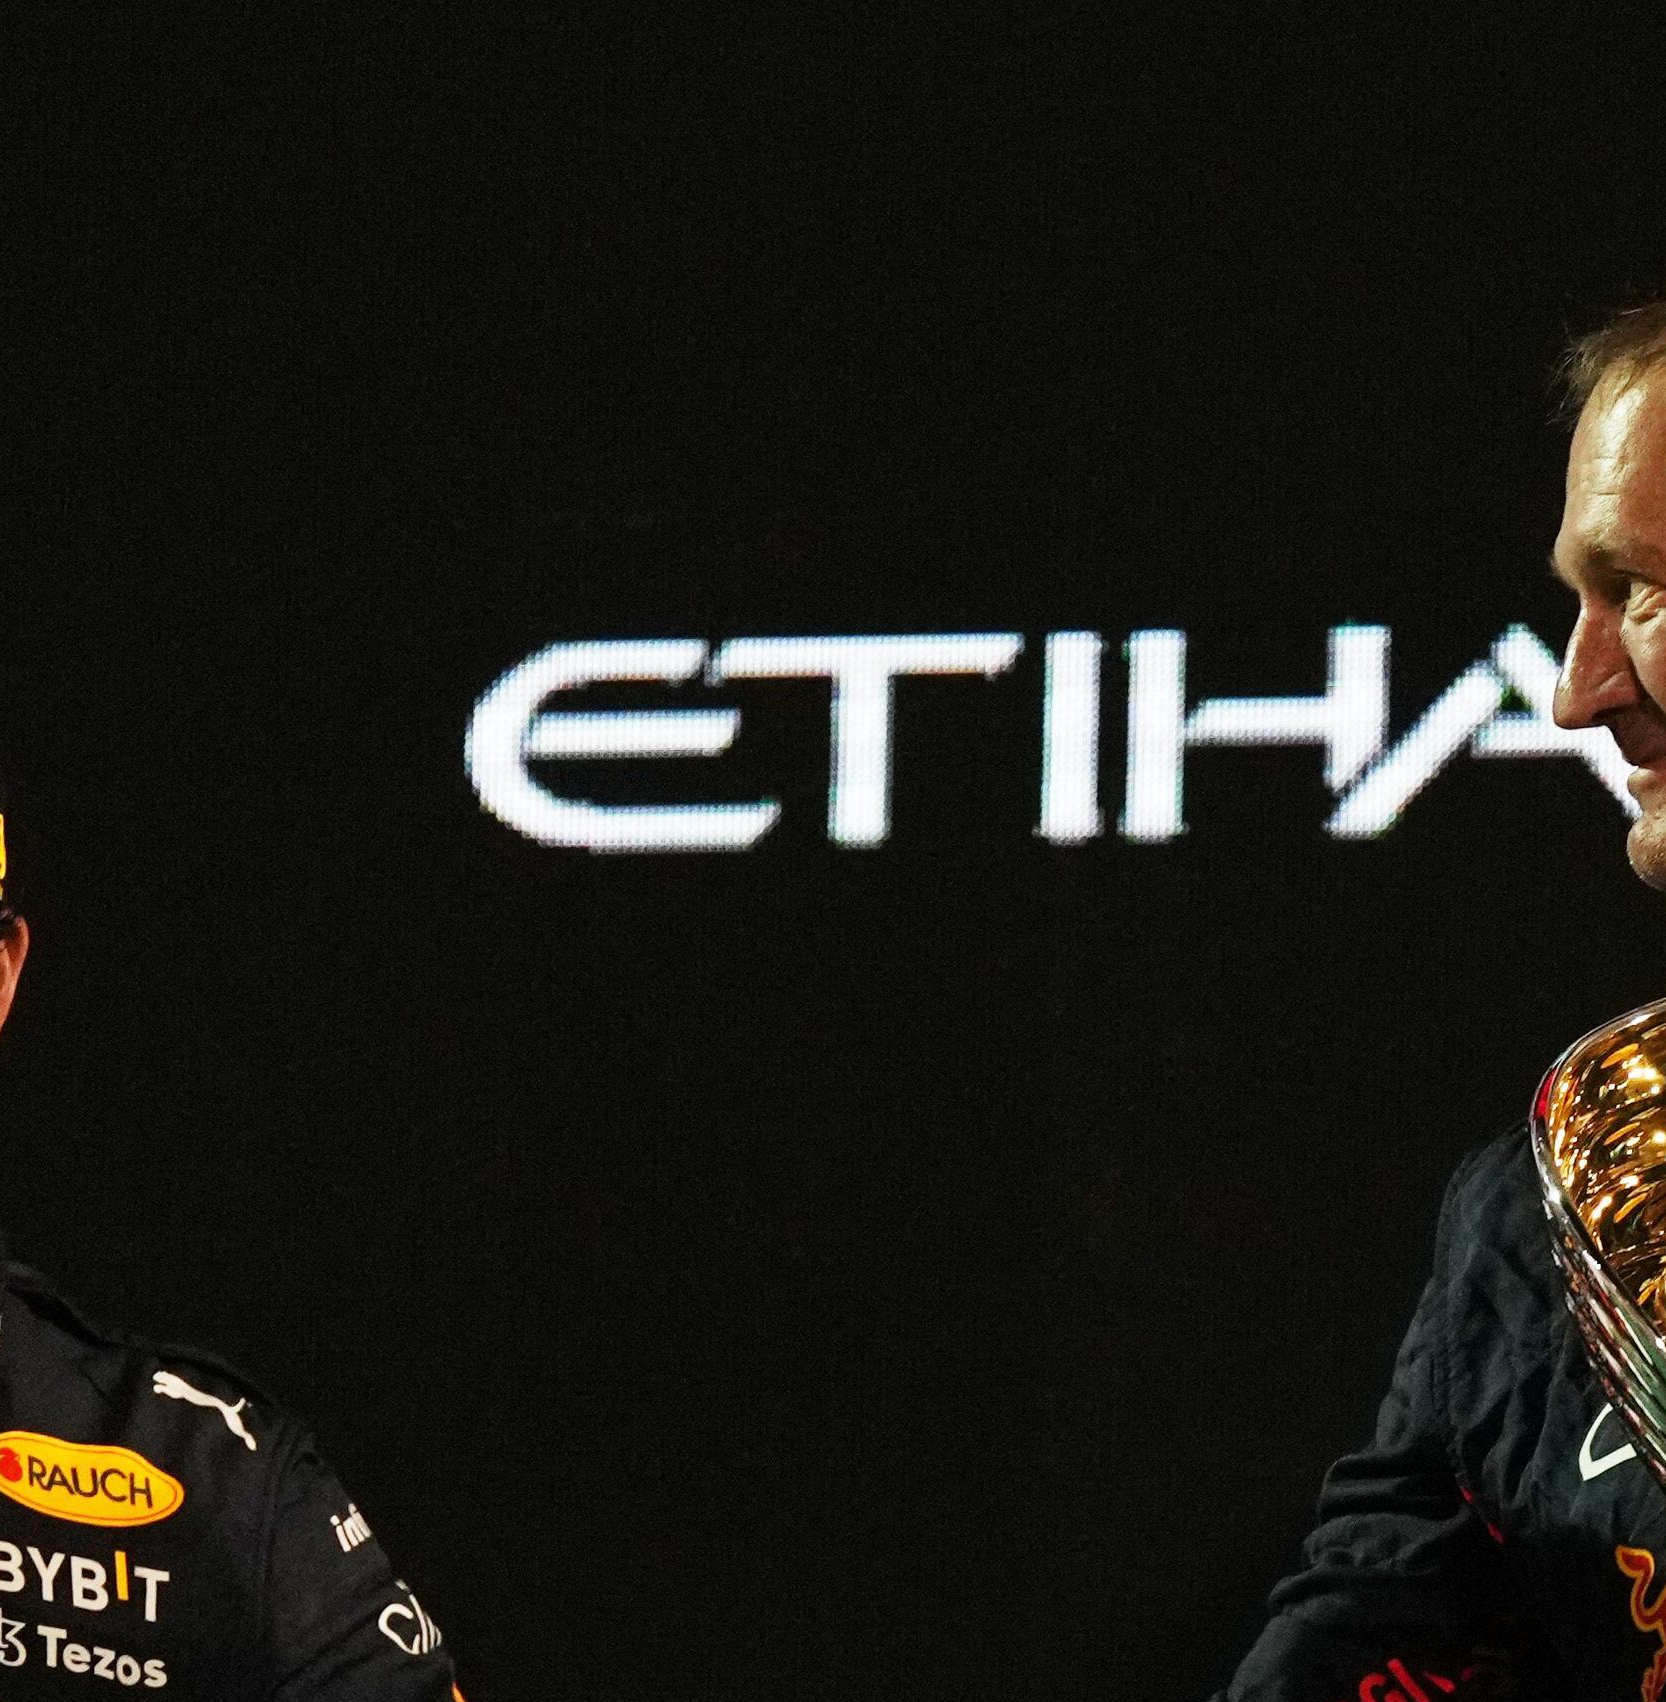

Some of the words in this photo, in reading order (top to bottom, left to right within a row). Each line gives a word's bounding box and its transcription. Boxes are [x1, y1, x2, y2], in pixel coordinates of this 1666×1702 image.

[465, 624, 1643, 852] ETIHA
[27, 1454, 154, 1509] RAUCH
[36, 1624, 168, 1688] Tezos
